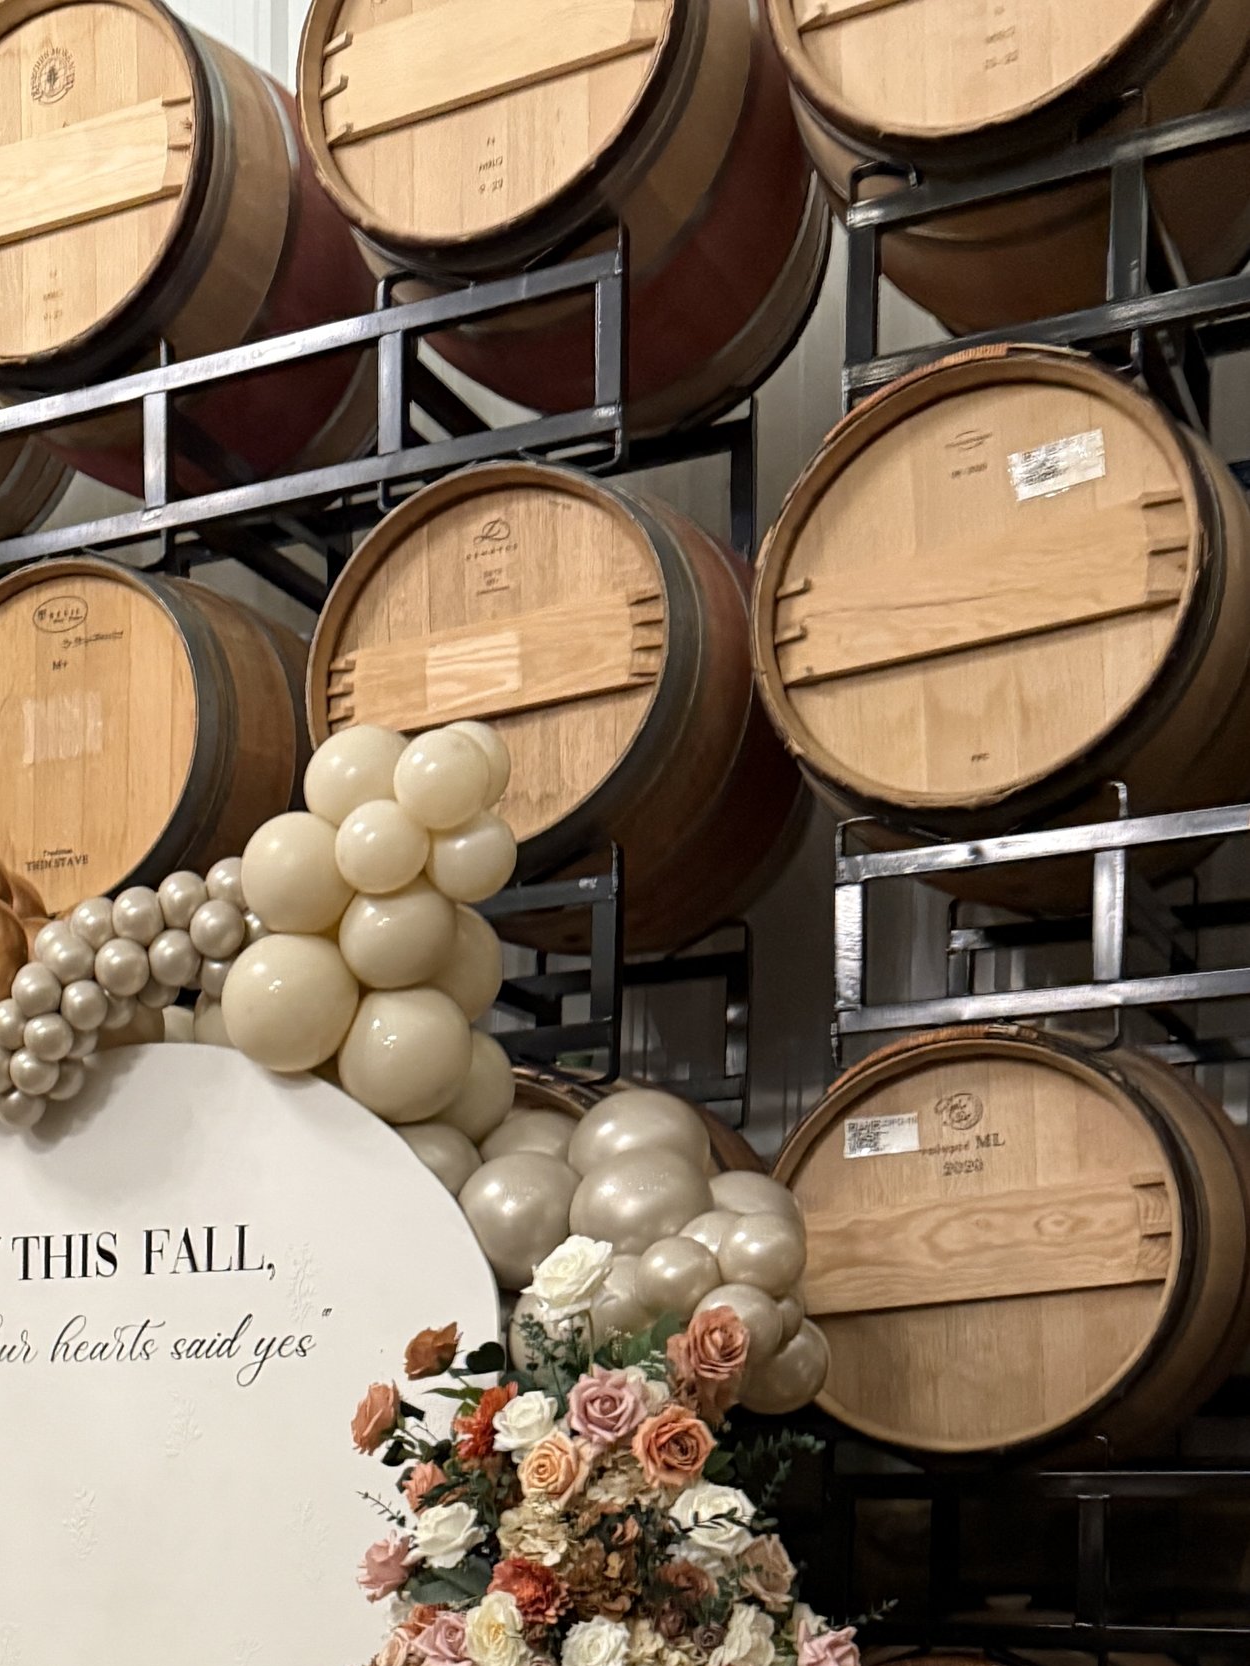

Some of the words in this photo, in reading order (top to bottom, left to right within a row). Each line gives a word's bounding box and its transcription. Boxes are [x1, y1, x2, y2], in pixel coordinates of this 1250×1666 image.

[975, 1133, 1006, 1149] ML
[142, 1224, 277, 1281] FALL,
[49, 1314, 166, 1363] hearts
[169, 1313, 253, 1361] said
